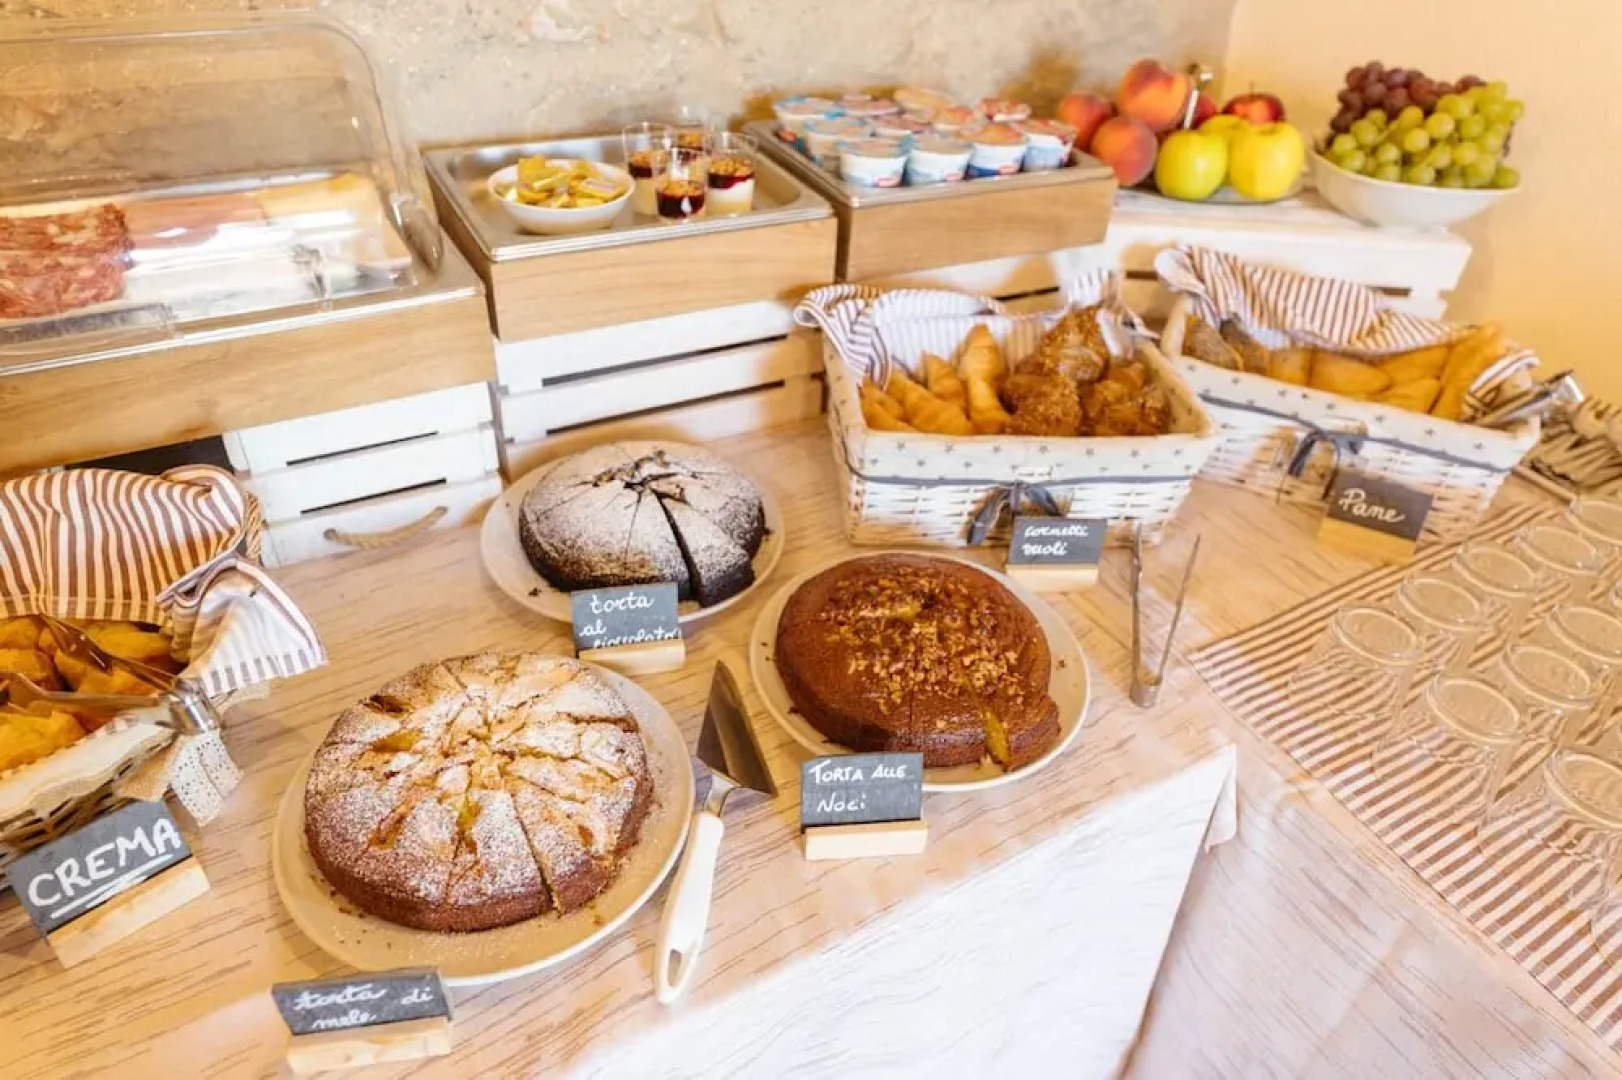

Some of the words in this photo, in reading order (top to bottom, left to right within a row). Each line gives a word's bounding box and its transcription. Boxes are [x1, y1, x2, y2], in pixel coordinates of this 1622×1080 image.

[1338, 487, 1406, 523] Pane
[589, 591, 655, 614] torta
[579, 618, 607, 637] al
[28, 818, 182, 907] CREMA
[292, 983, 388, 1011] torta
[401, 986, 434, 1005] di
